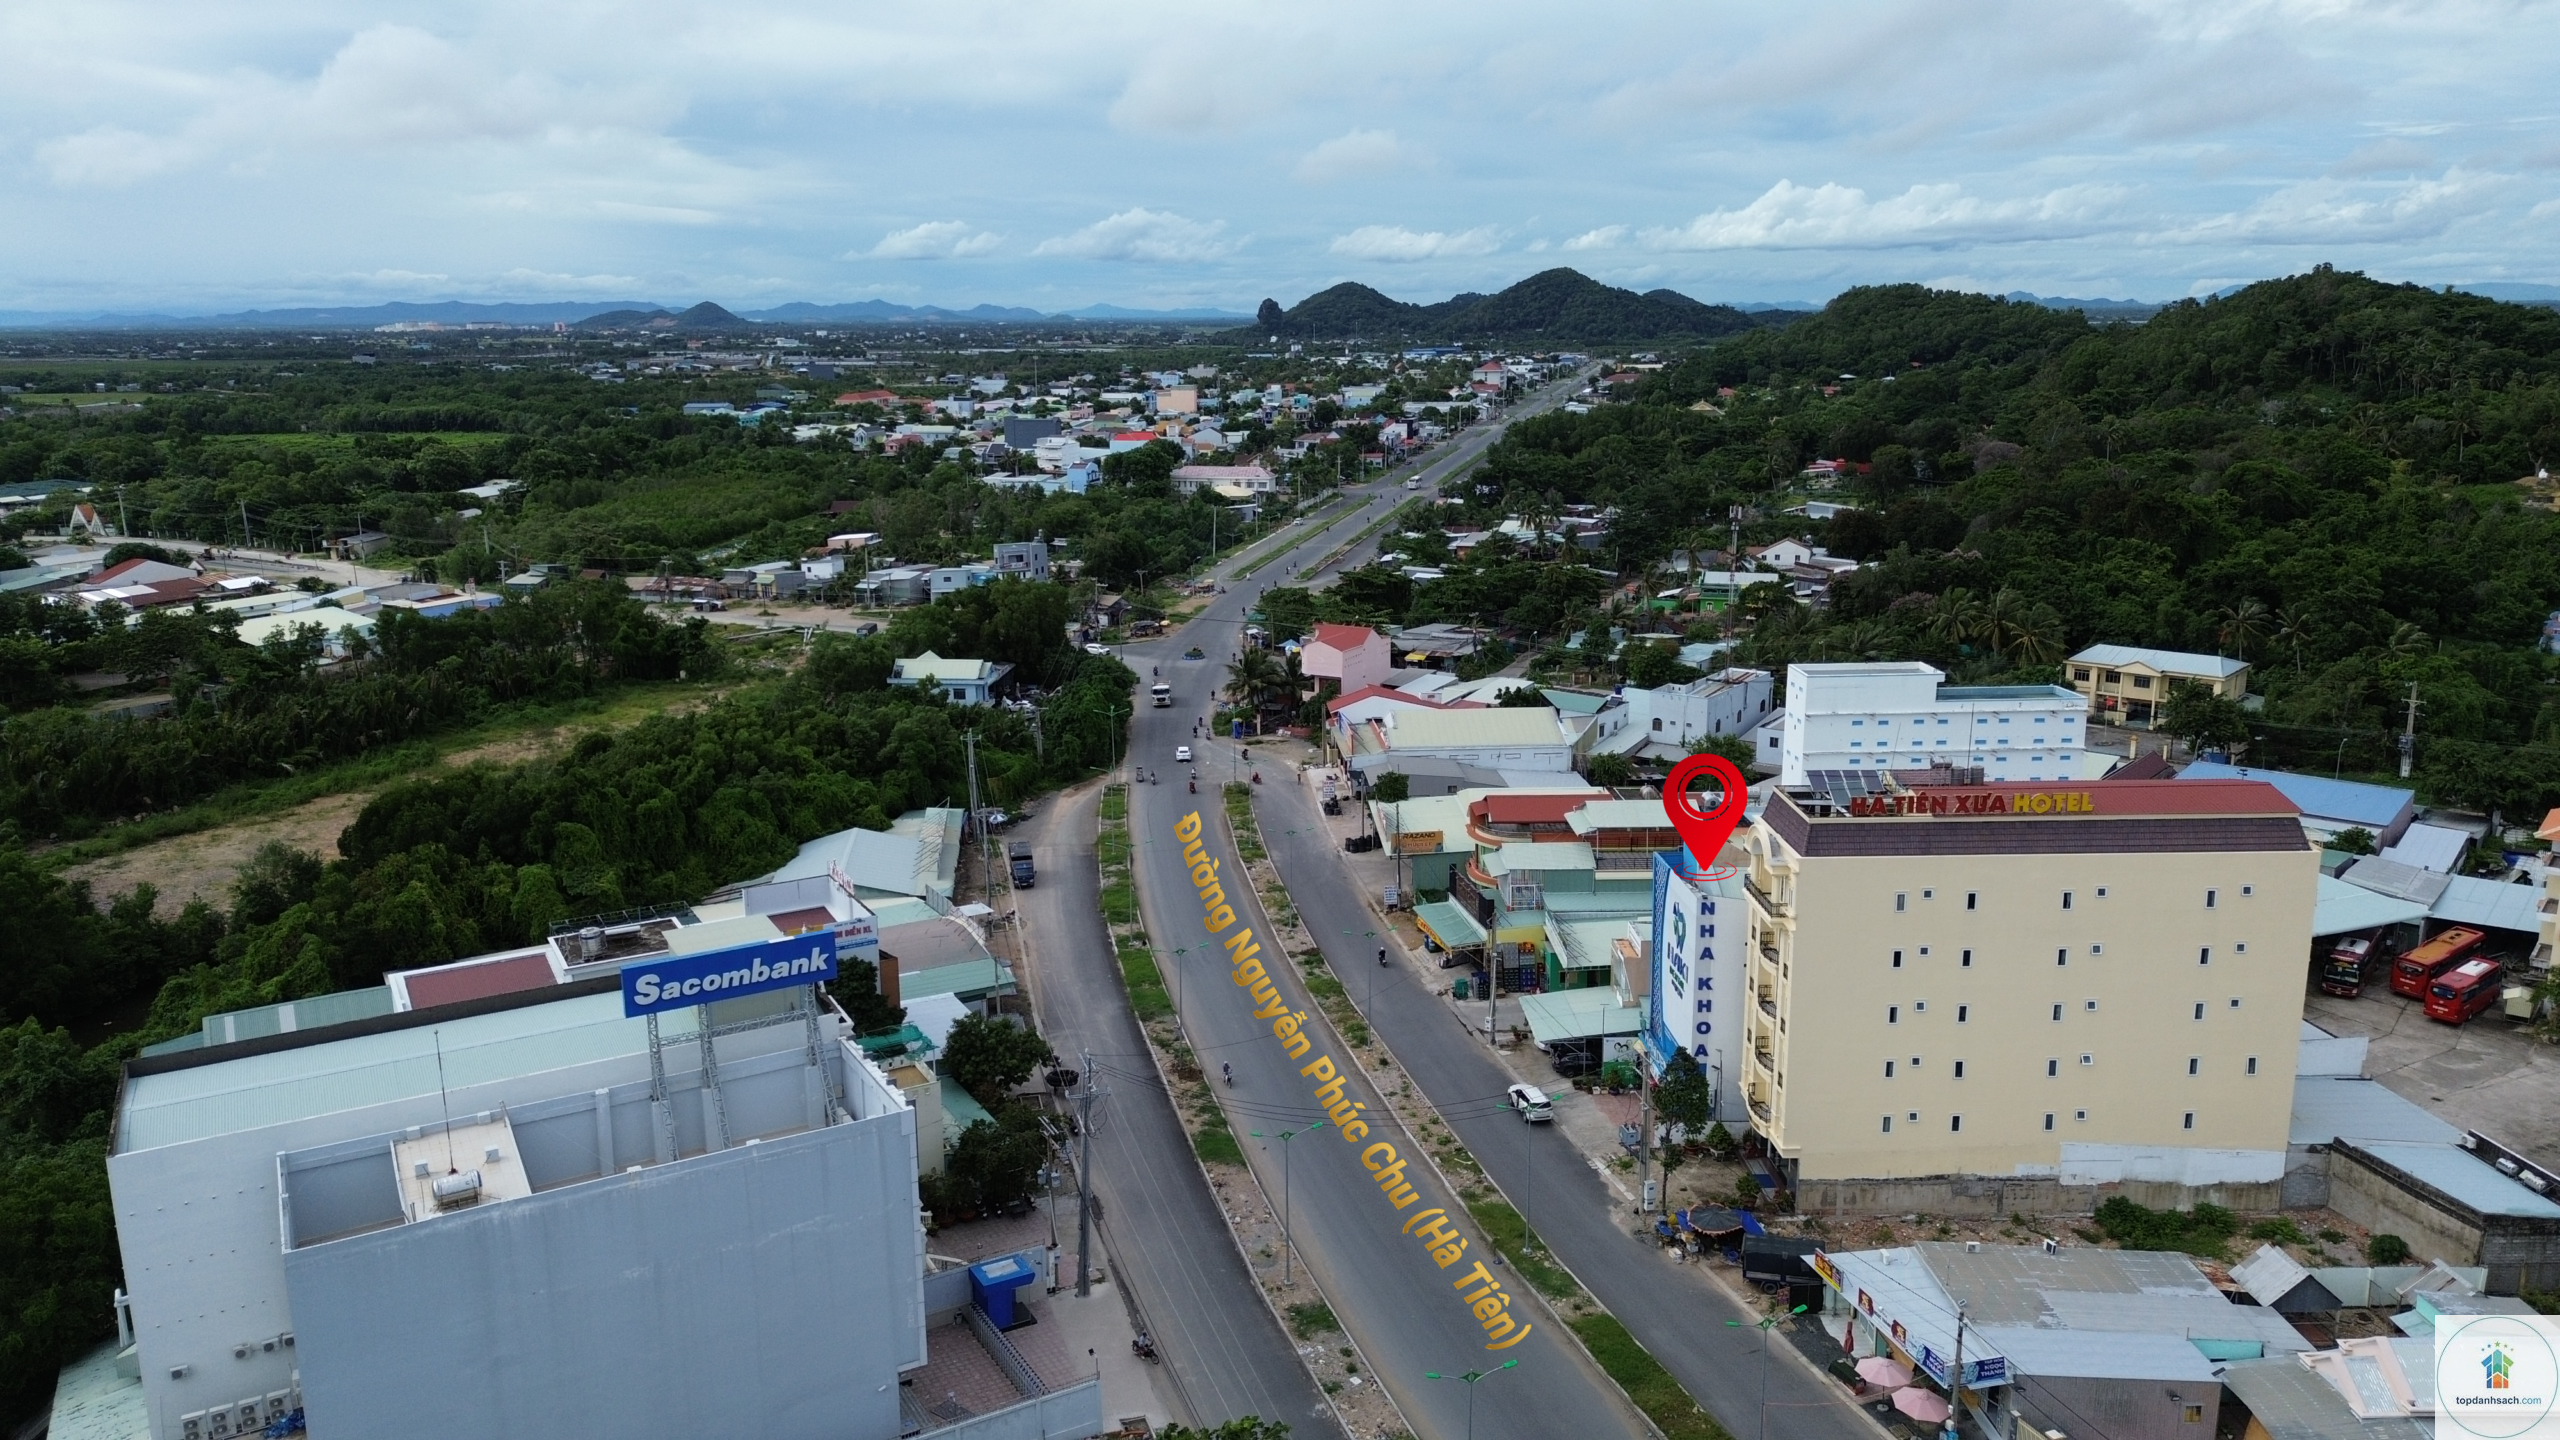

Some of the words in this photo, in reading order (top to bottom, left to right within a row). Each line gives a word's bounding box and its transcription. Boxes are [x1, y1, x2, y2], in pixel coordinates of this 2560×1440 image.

[1892, 791, 1947, 814] TIÊN
[1953, 792, 2007, 813] XƯA
[2013, 792, 2094, 814] HOTEL
[1699, 902, 1716, 960] NHA
[633, 947, 830, 1006] Sacombank
[1694, 977, 1714, 1057] KHOA
